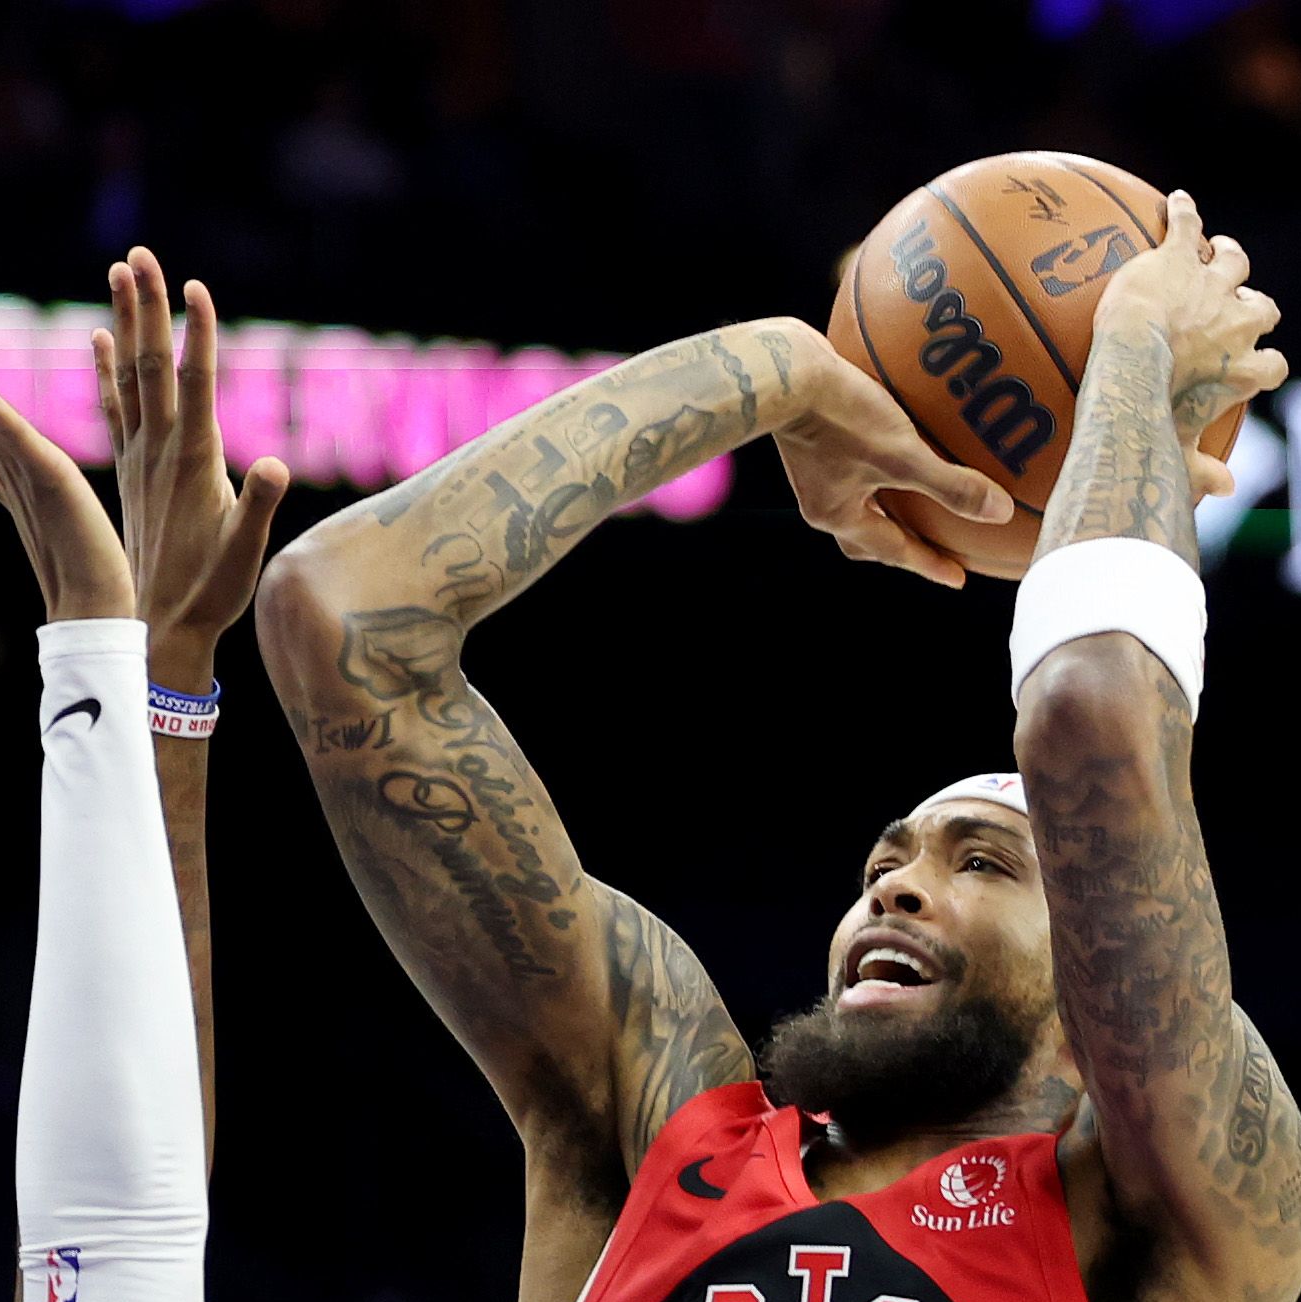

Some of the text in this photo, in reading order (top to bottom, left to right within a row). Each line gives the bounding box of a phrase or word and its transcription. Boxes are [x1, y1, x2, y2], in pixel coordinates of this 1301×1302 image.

[889, 218, 1057, 478] Wilson
[911, 1200, 1016, 1232] Sun Life
